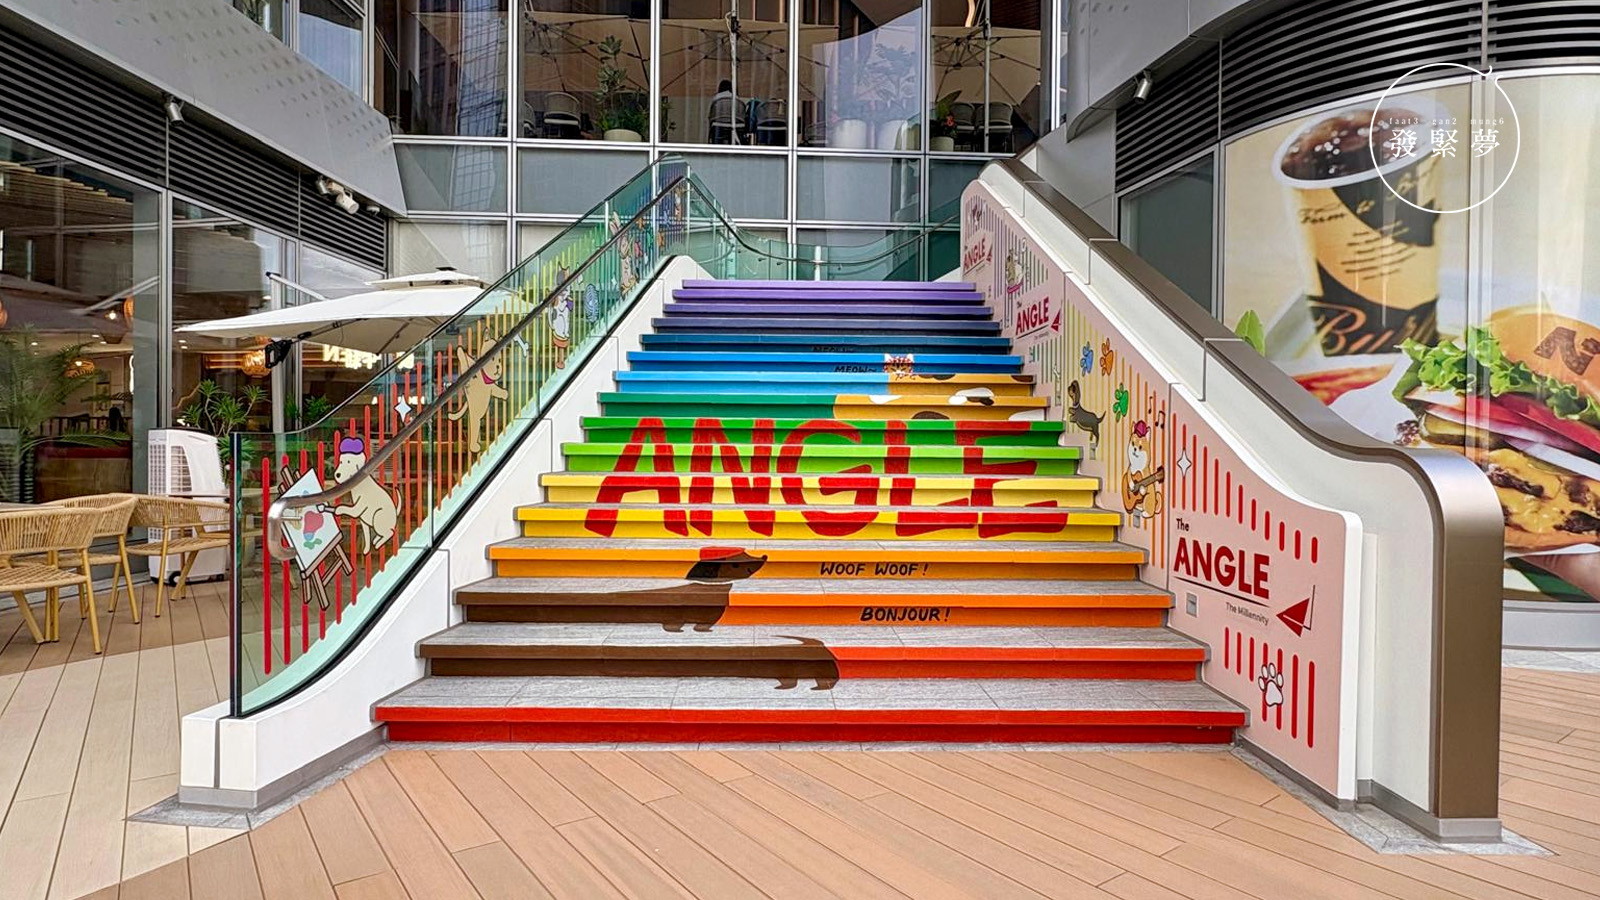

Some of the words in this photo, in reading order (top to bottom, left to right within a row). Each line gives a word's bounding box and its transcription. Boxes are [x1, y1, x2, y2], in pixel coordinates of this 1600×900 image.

[1015, 296, 1050, 336] ANGLE
[584, 417, 1069, 538] ANGLE
[1175, 518, 1190, 532] The
[820, 561, 866, 576] WOOF
[1173, 536, 1270, 600] ANGLE
[1225, 602, 1237, 614] The
[1238, 605, 1270, 626] Millennity
